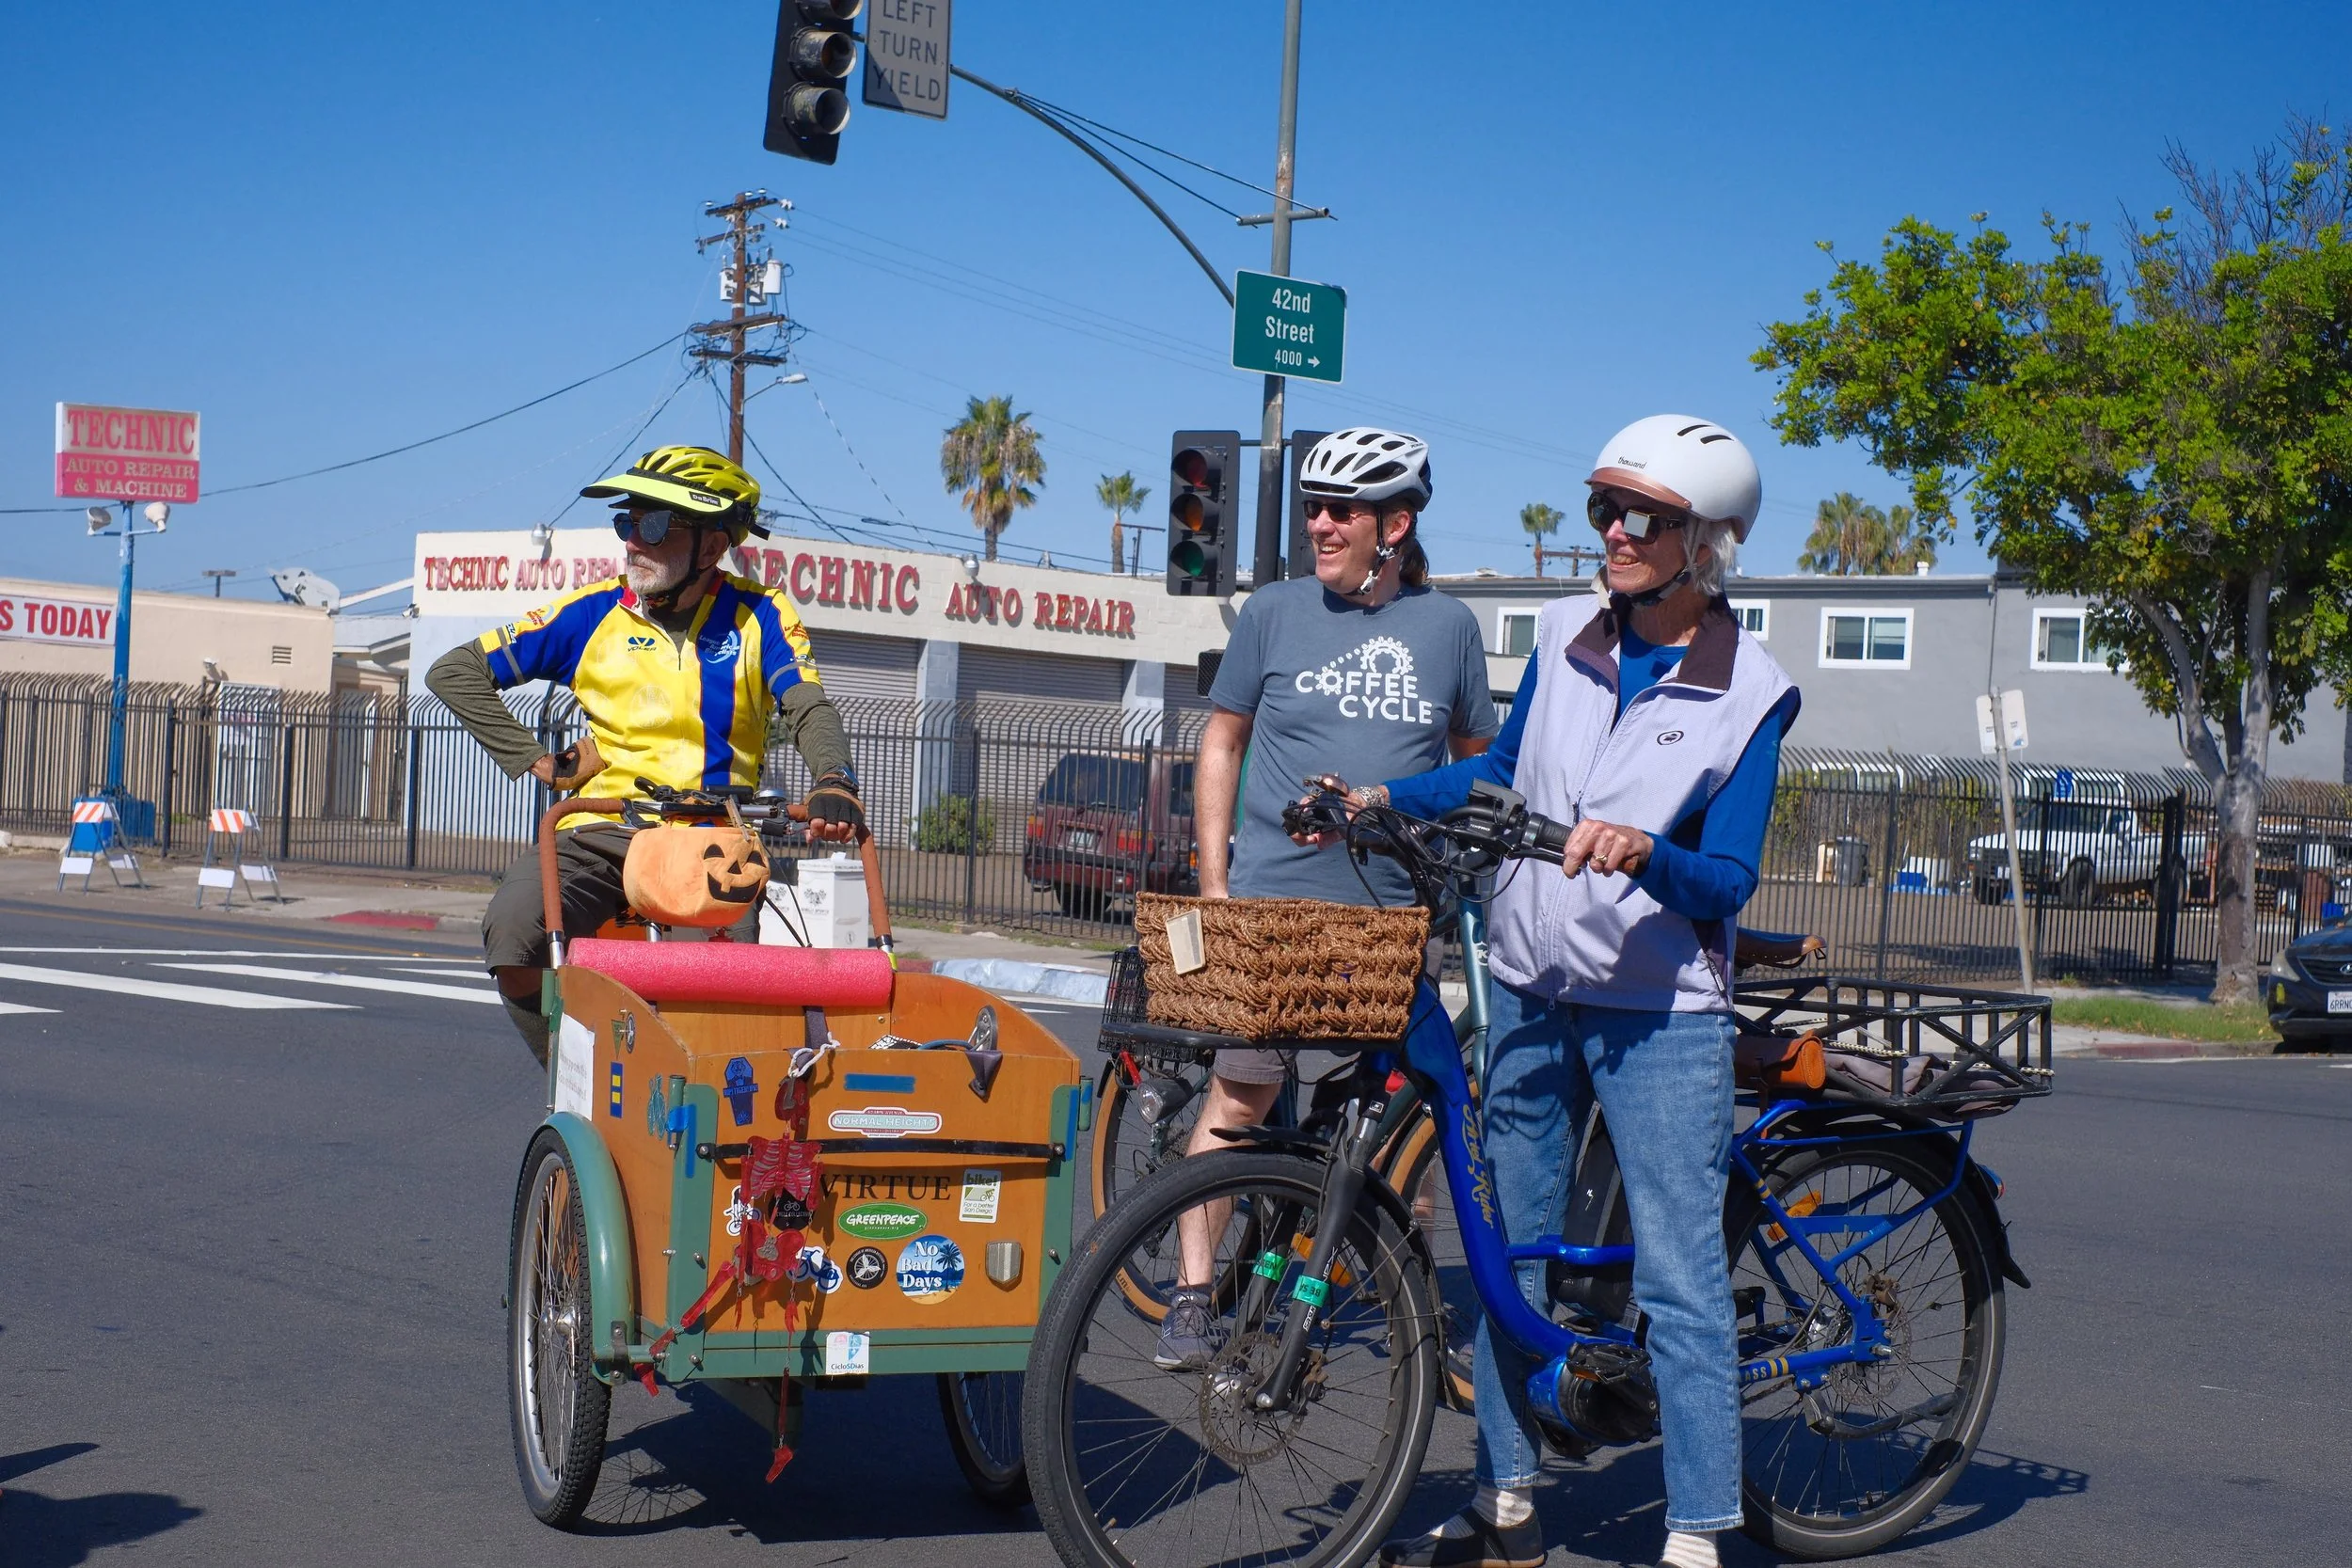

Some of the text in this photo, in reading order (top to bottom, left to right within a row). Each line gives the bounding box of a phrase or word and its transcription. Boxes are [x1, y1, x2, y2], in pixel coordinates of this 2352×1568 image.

[882, 0, 936, 27] LEFT
[880, 30, 937, 63] TURN
[873, 65, 941, 101] YIELD
[1272, 288, 1311, 313] 42nd
[1265, 316, 1313, 343] Street
[1275, 349, 1302, 366] 4000
[67, 409, 195, 454] TECHNIC
[67, 458, 195, 480] AUTO REPAIR
[1618, 456, 1647, 468] thousand
[74, 478, 187, 498] & MACHINE
[424, 556, 628, 590] TECHNIC AUTO REPA
[738, 546, 1135, 635] TECHNIC AUTO REPAIR
[24, 602, 112, 639] TODAY
[1295, 670, 1418, 699] COFFEE
[1339, 694, 1433, 724] CYCLE
[834, 1116, 936, 1129] NORMAL HEIGHTS
[820, 1174, 951, 1200] VIRTUE
[966, 1173, 998, 1187] bike!
[847, 1214, 919, 1226] GREENPEACE
[914, 1241, 939, 1257] No
[901, 1258, 933, 1272] Bad
[903, 1274, 943, 1293] Days
